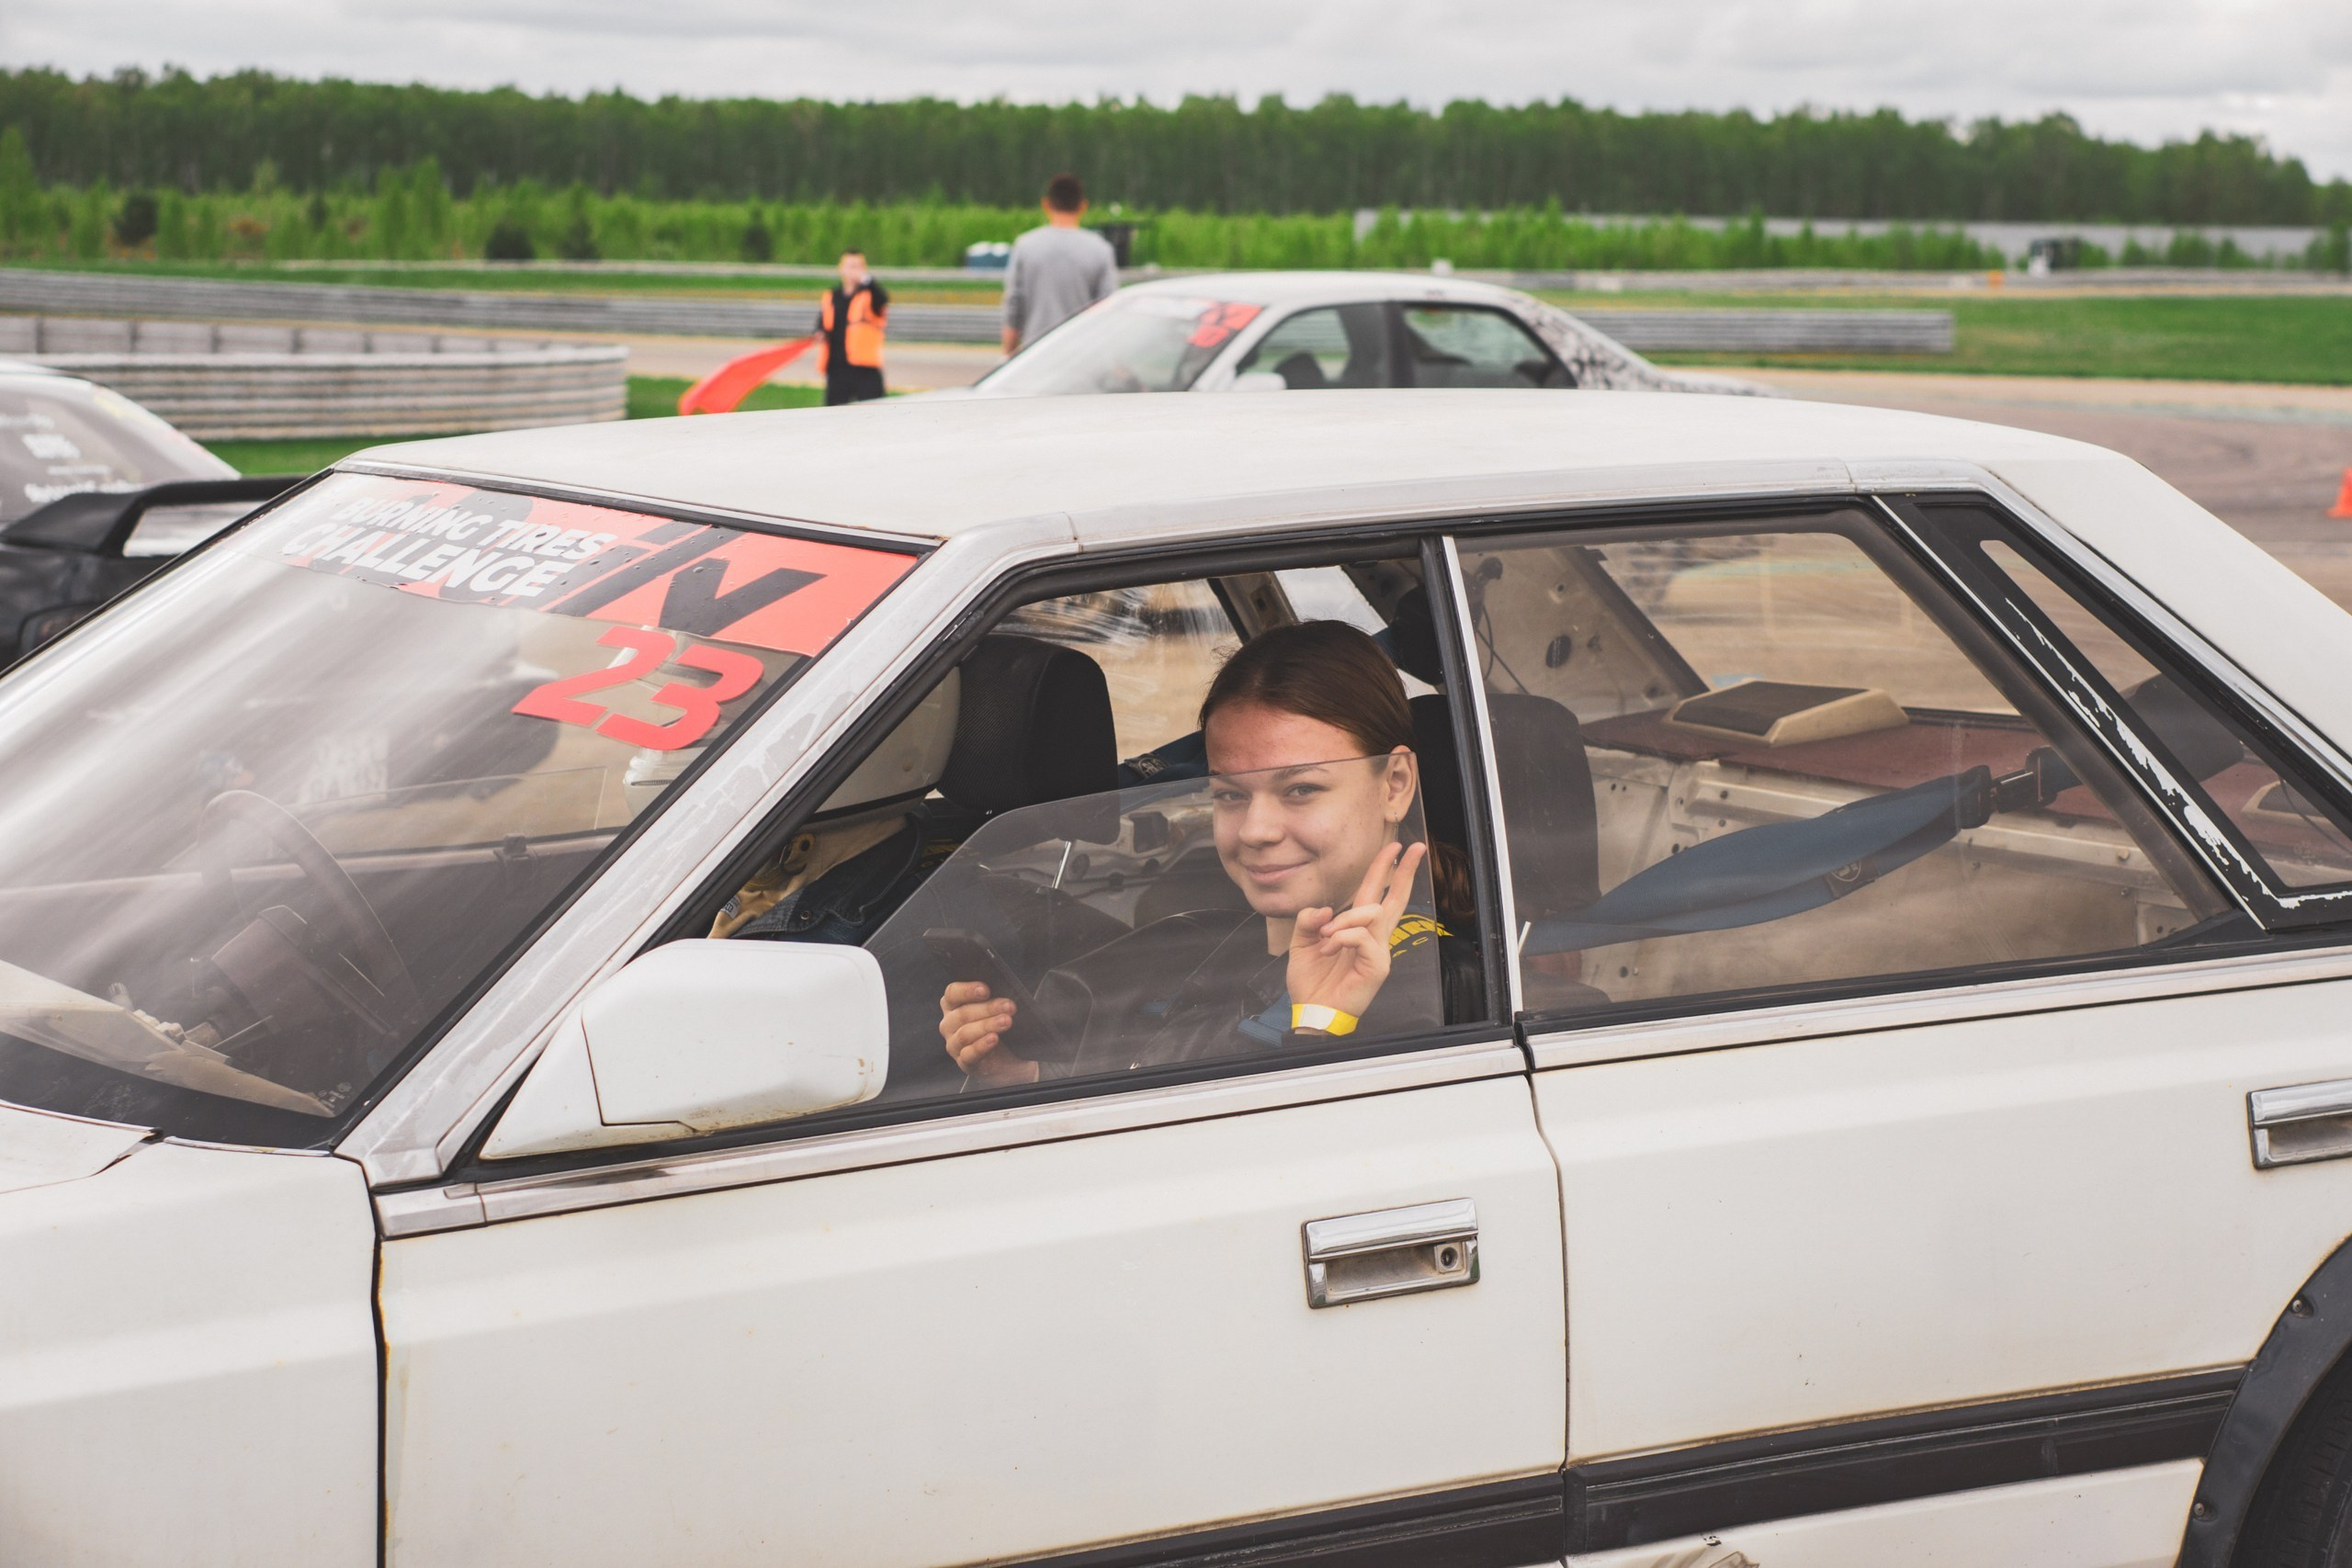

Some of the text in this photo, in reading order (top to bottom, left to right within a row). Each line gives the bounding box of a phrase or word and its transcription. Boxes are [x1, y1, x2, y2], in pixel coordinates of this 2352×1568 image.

[283, 522, 578, 597] CHALLENGE
[331, 496, 618, 559] BURNING TIRES
[511, 625, 764, 751] 23
